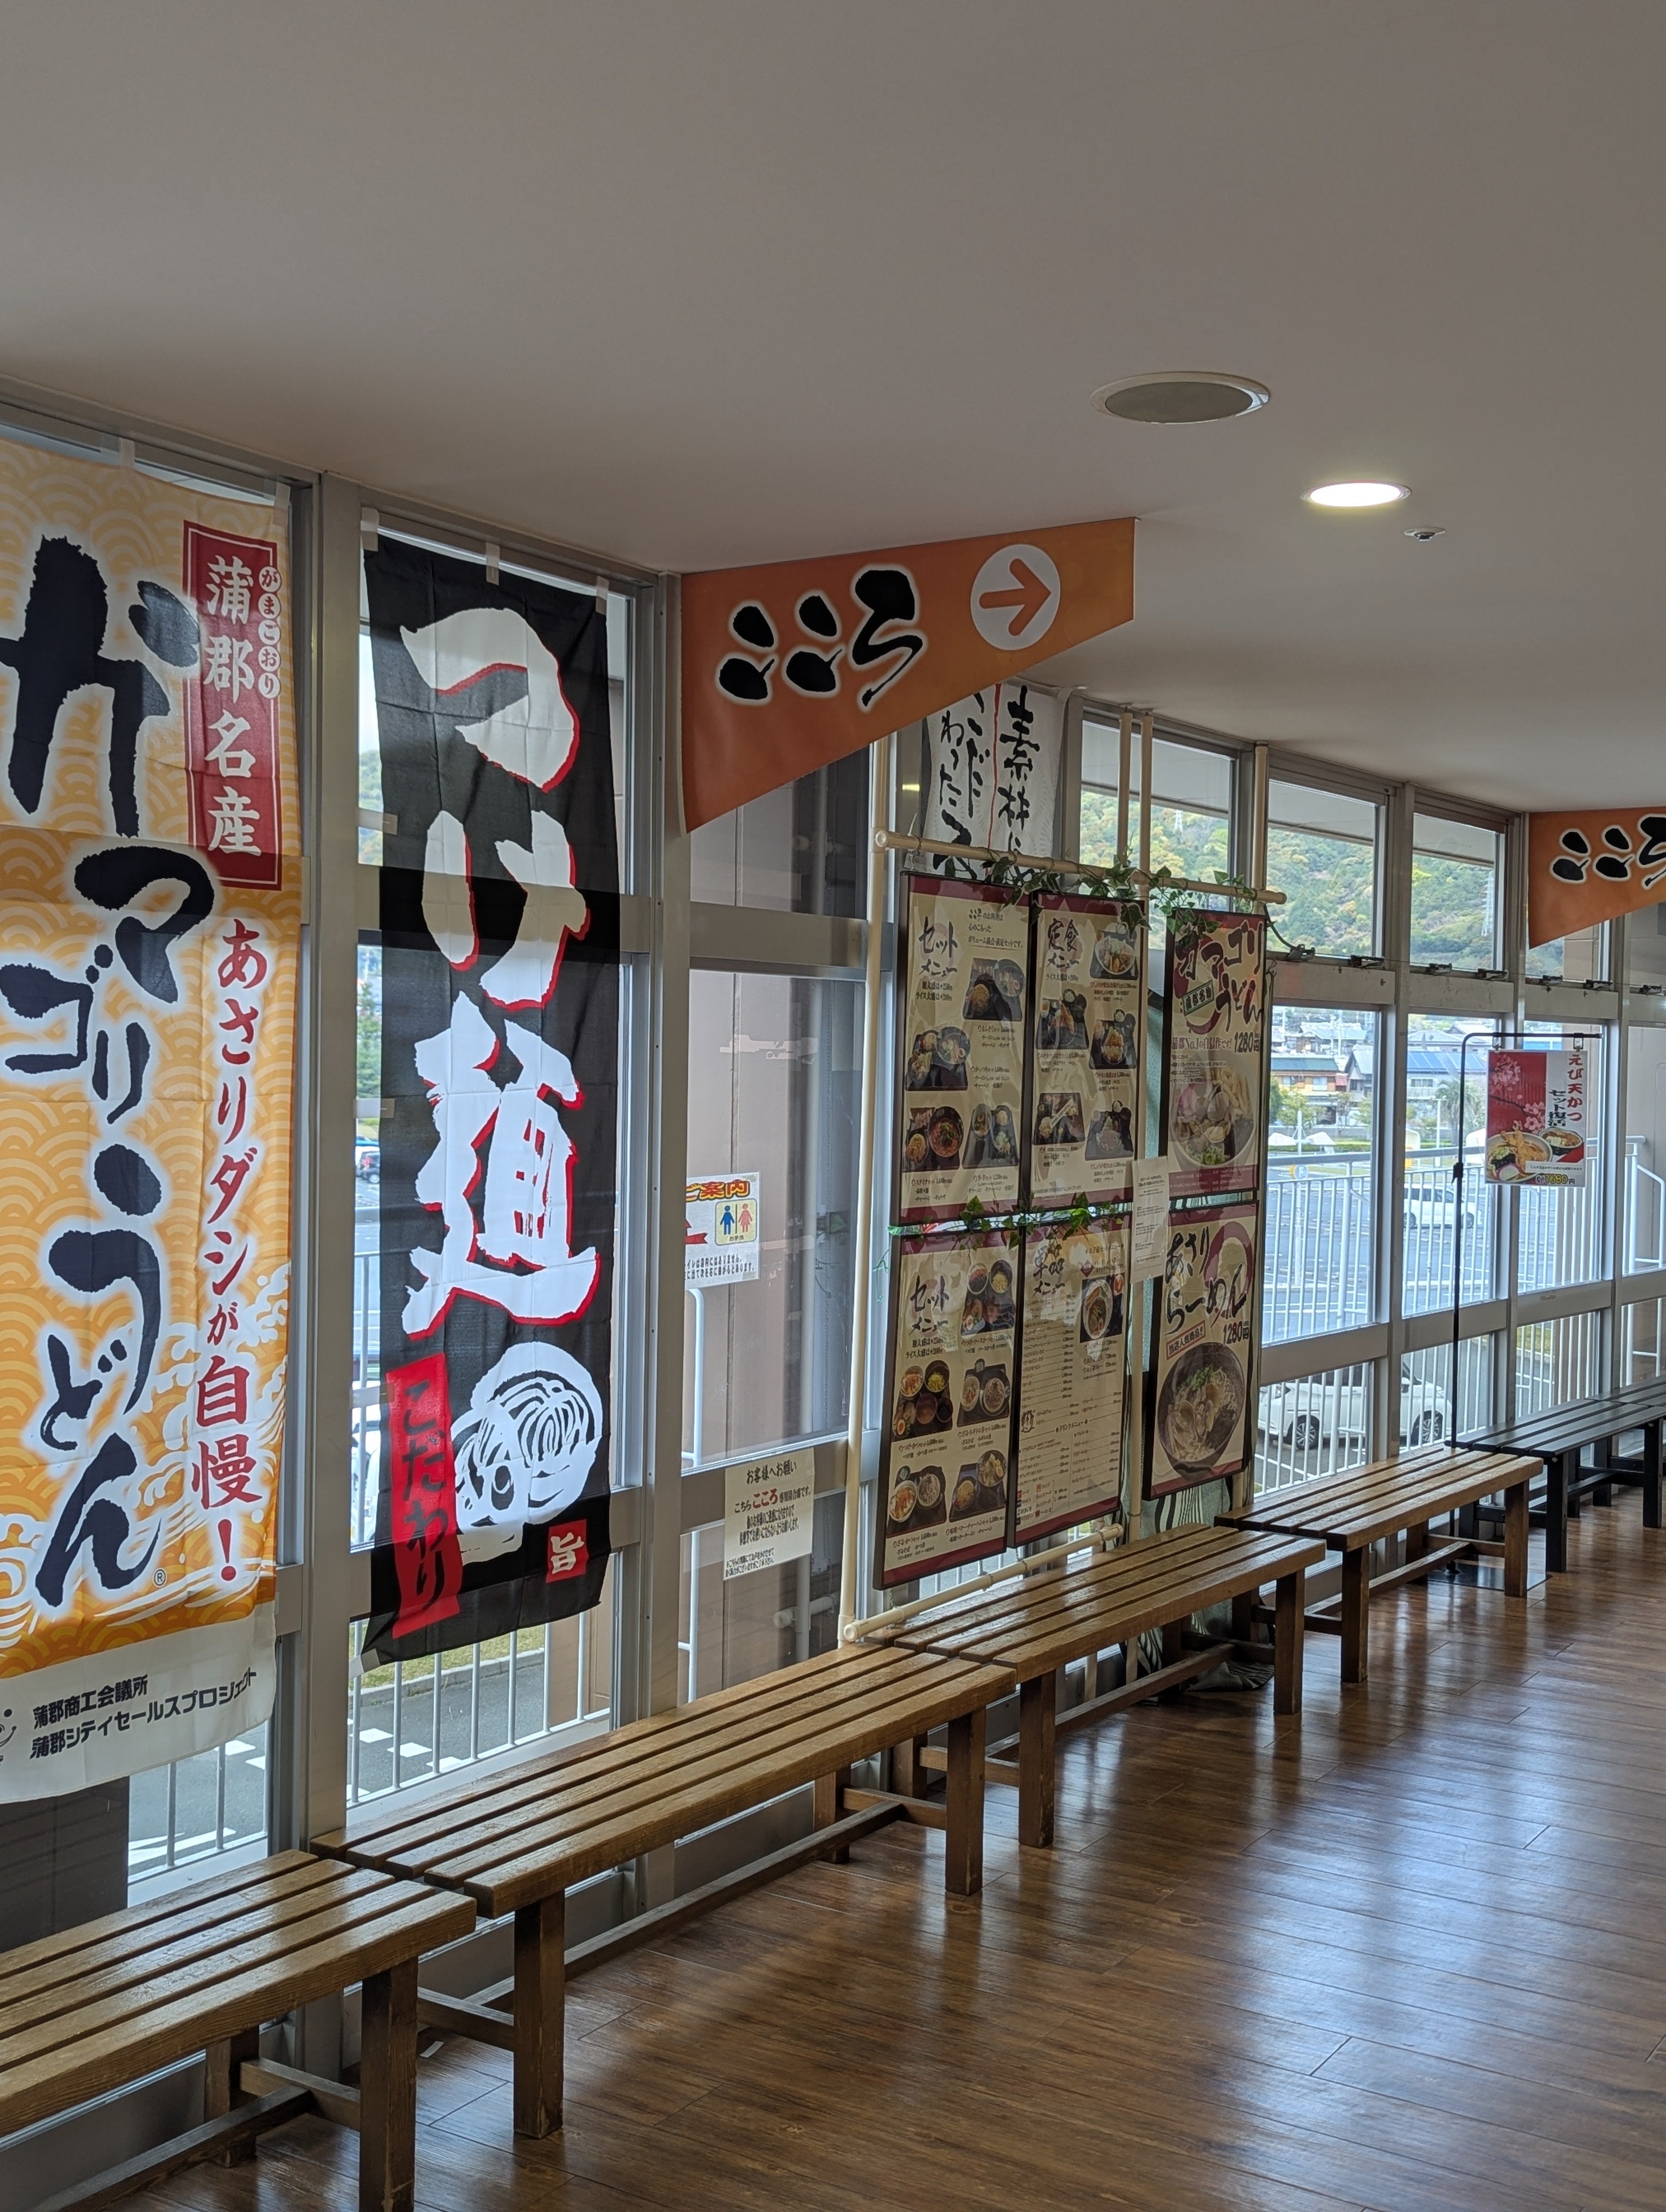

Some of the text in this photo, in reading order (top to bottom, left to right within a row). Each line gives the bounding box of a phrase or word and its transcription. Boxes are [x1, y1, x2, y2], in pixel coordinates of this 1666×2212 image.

[258, 565, 281, 699] がまごおり
[717, 568, 925, 708] こころ
[203, 555, 262, 857] 蒲郡名産
[918, 916, 958, 958] セット
[918, 959, 958, 978] メニュー
[1046, 953, 1080, 969] メニュー
[1567, 1053, 1584, 1122] えび天かつ
[684, 1253, 742, 1269] イレは店内にはありません。
[910, 1275, 950, 1312] セット
[909, 1316, 949, 1335] メニュー
[746, 1459, 797, 1484] お客様へお願い
[402, 1380, 448, 1611] こだわり
[550, 1532, 585, 1575] 旨
[29, 1667, 257, 1760] 蒲郡シティセールスプロジェクト
[33, 1674, 148, 1730] 蒲郡商工会議所
